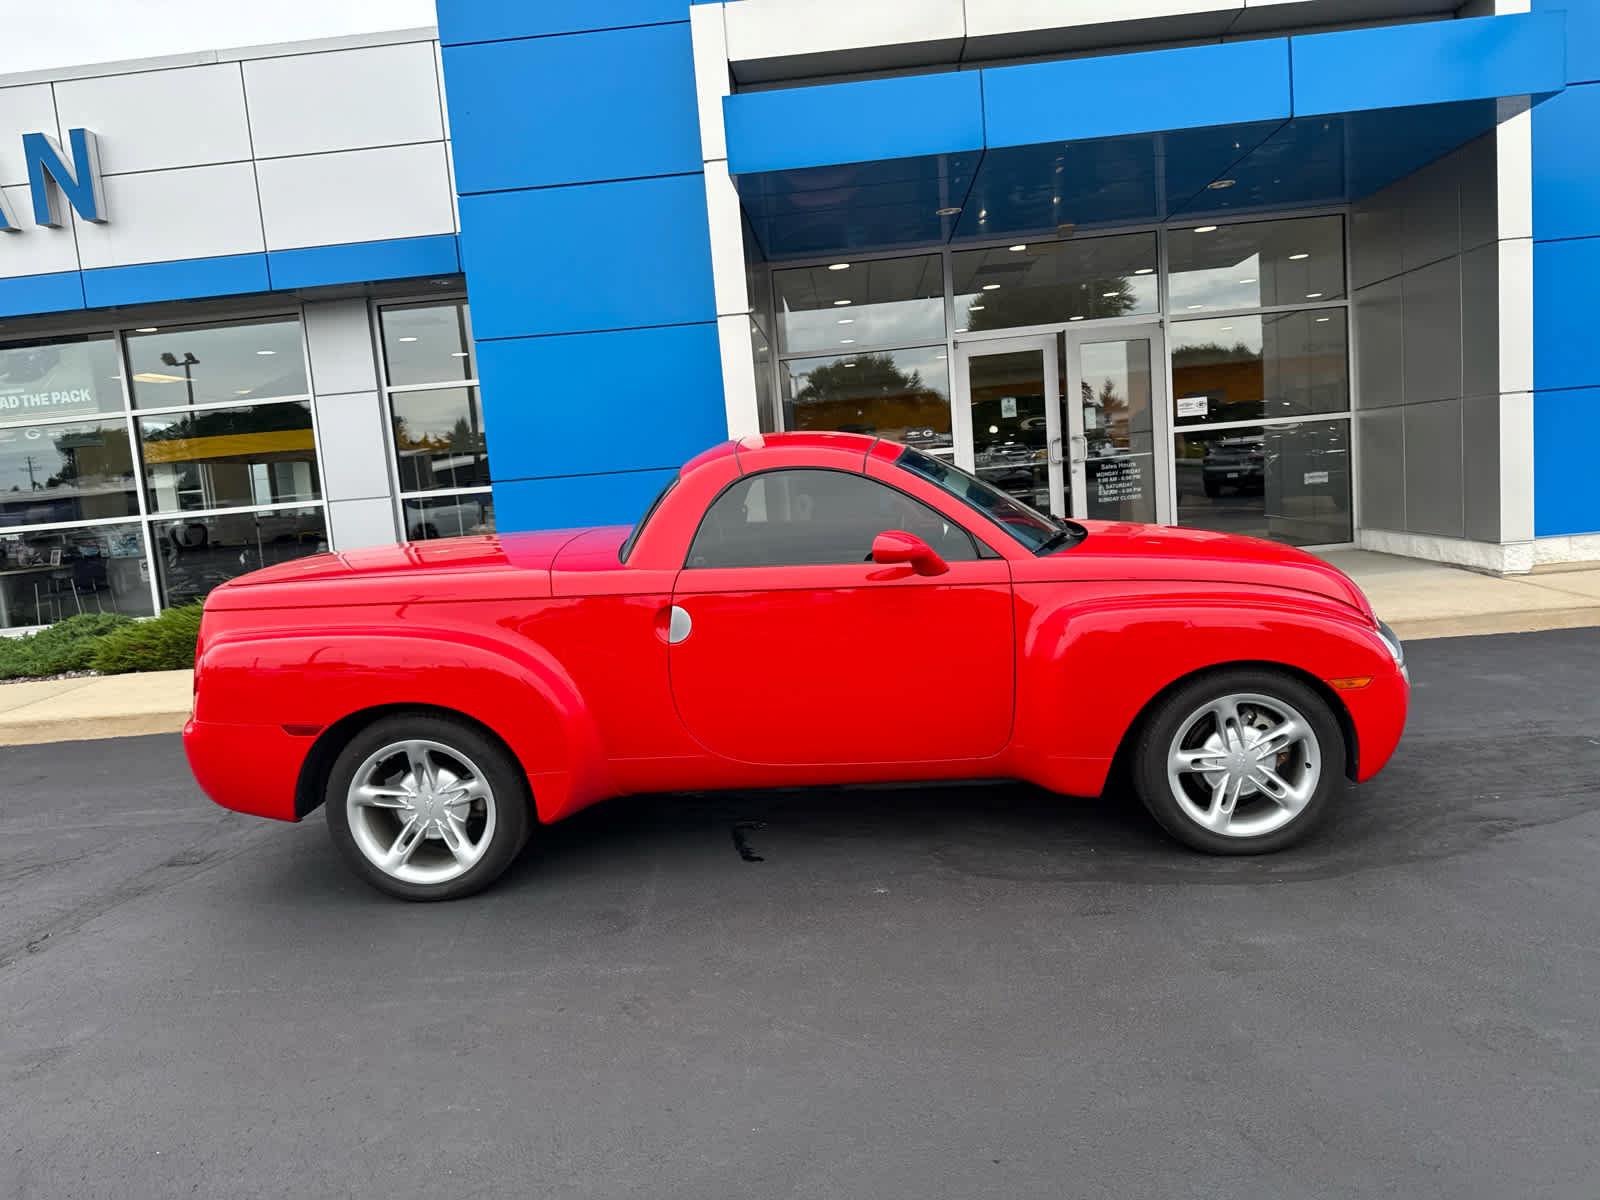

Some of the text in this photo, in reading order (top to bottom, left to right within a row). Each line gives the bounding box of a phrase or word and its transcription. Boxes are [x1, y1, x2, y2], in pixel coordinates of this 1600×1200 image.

[0, 128, 107, 231] N
[20, 393, 50, 407] THE
[51, 388, 91, 404] PACK
